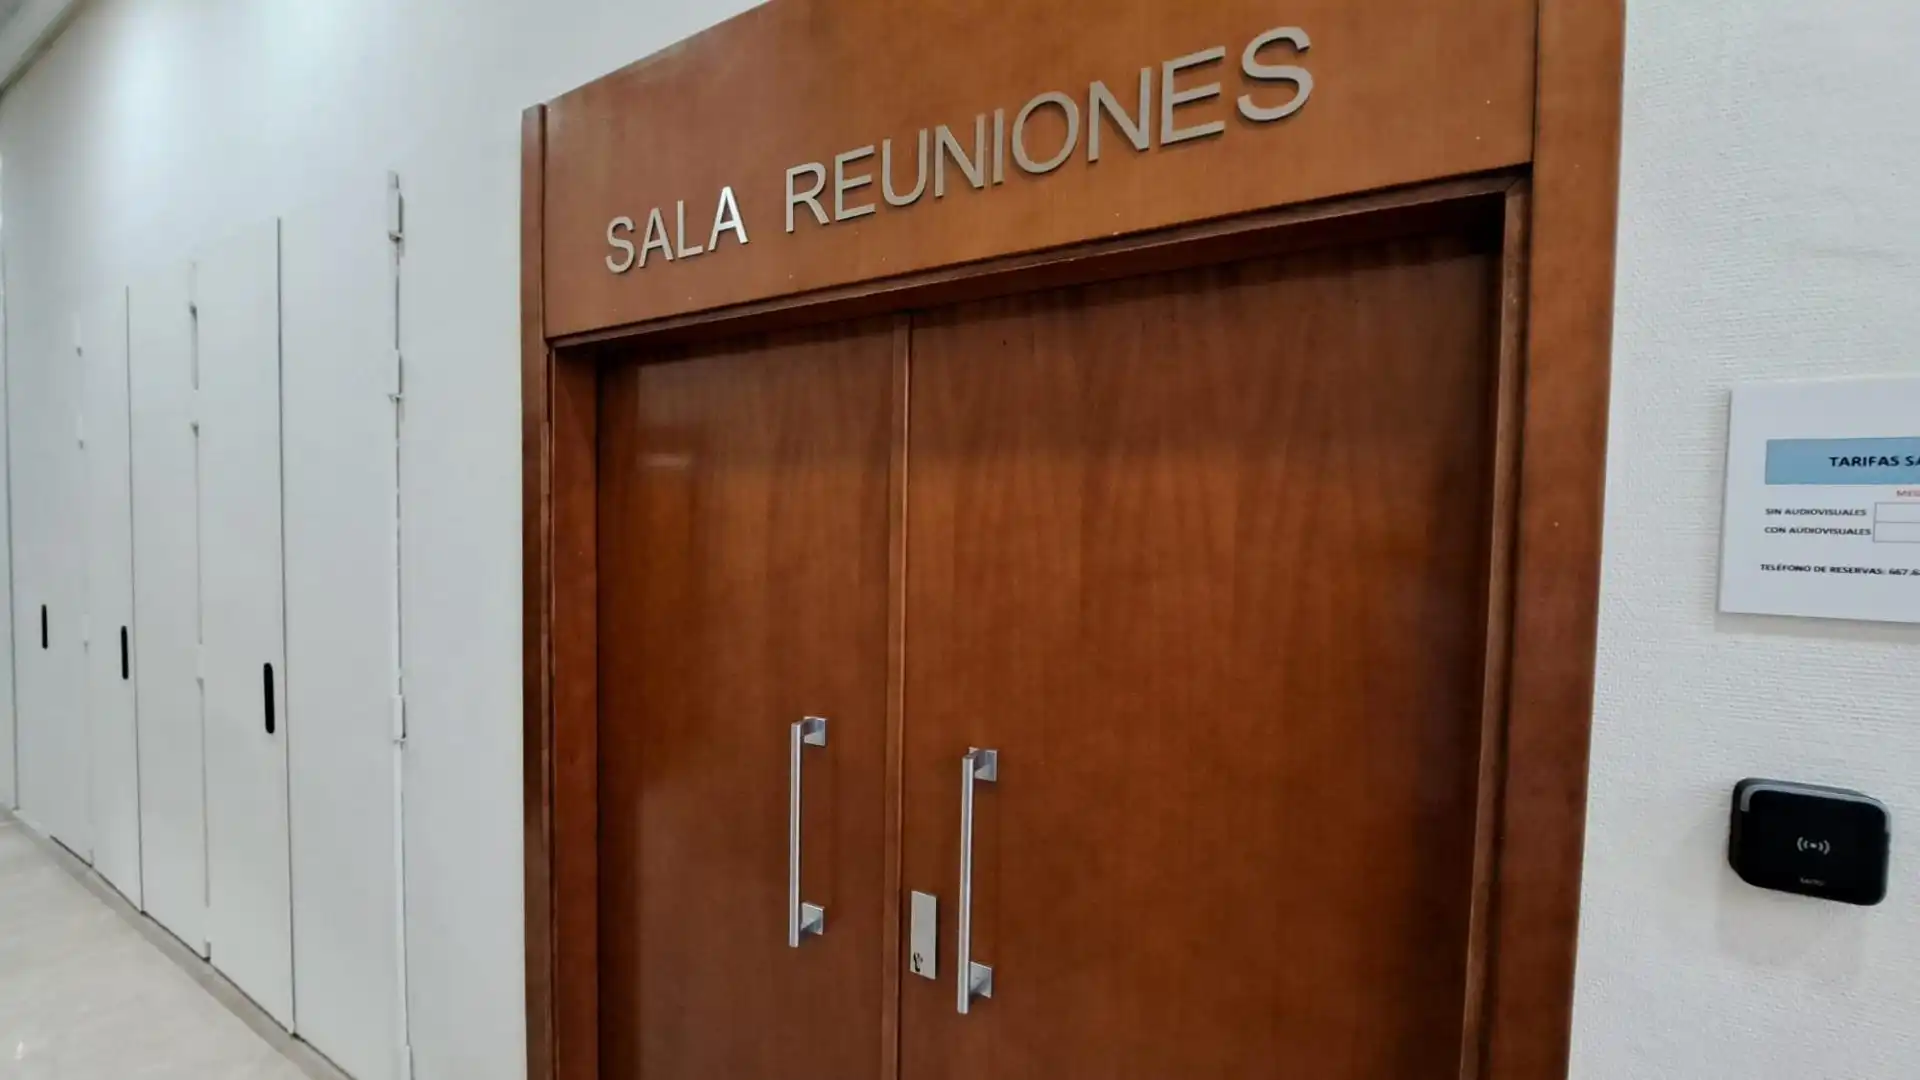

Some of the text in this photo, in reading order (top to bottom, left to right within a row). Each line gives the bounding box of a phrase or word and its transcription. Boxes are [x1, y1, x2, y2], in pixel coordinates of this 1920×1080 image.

[605, 26, 1314, 273] SALA REUNIONES
[1829, 455, 1900, 468] TARIFAS
[1785, 508, 1867, 516] AUDIOVISUALES
[1764, 526, 1871, 535] CON AUDIOVISUALES
